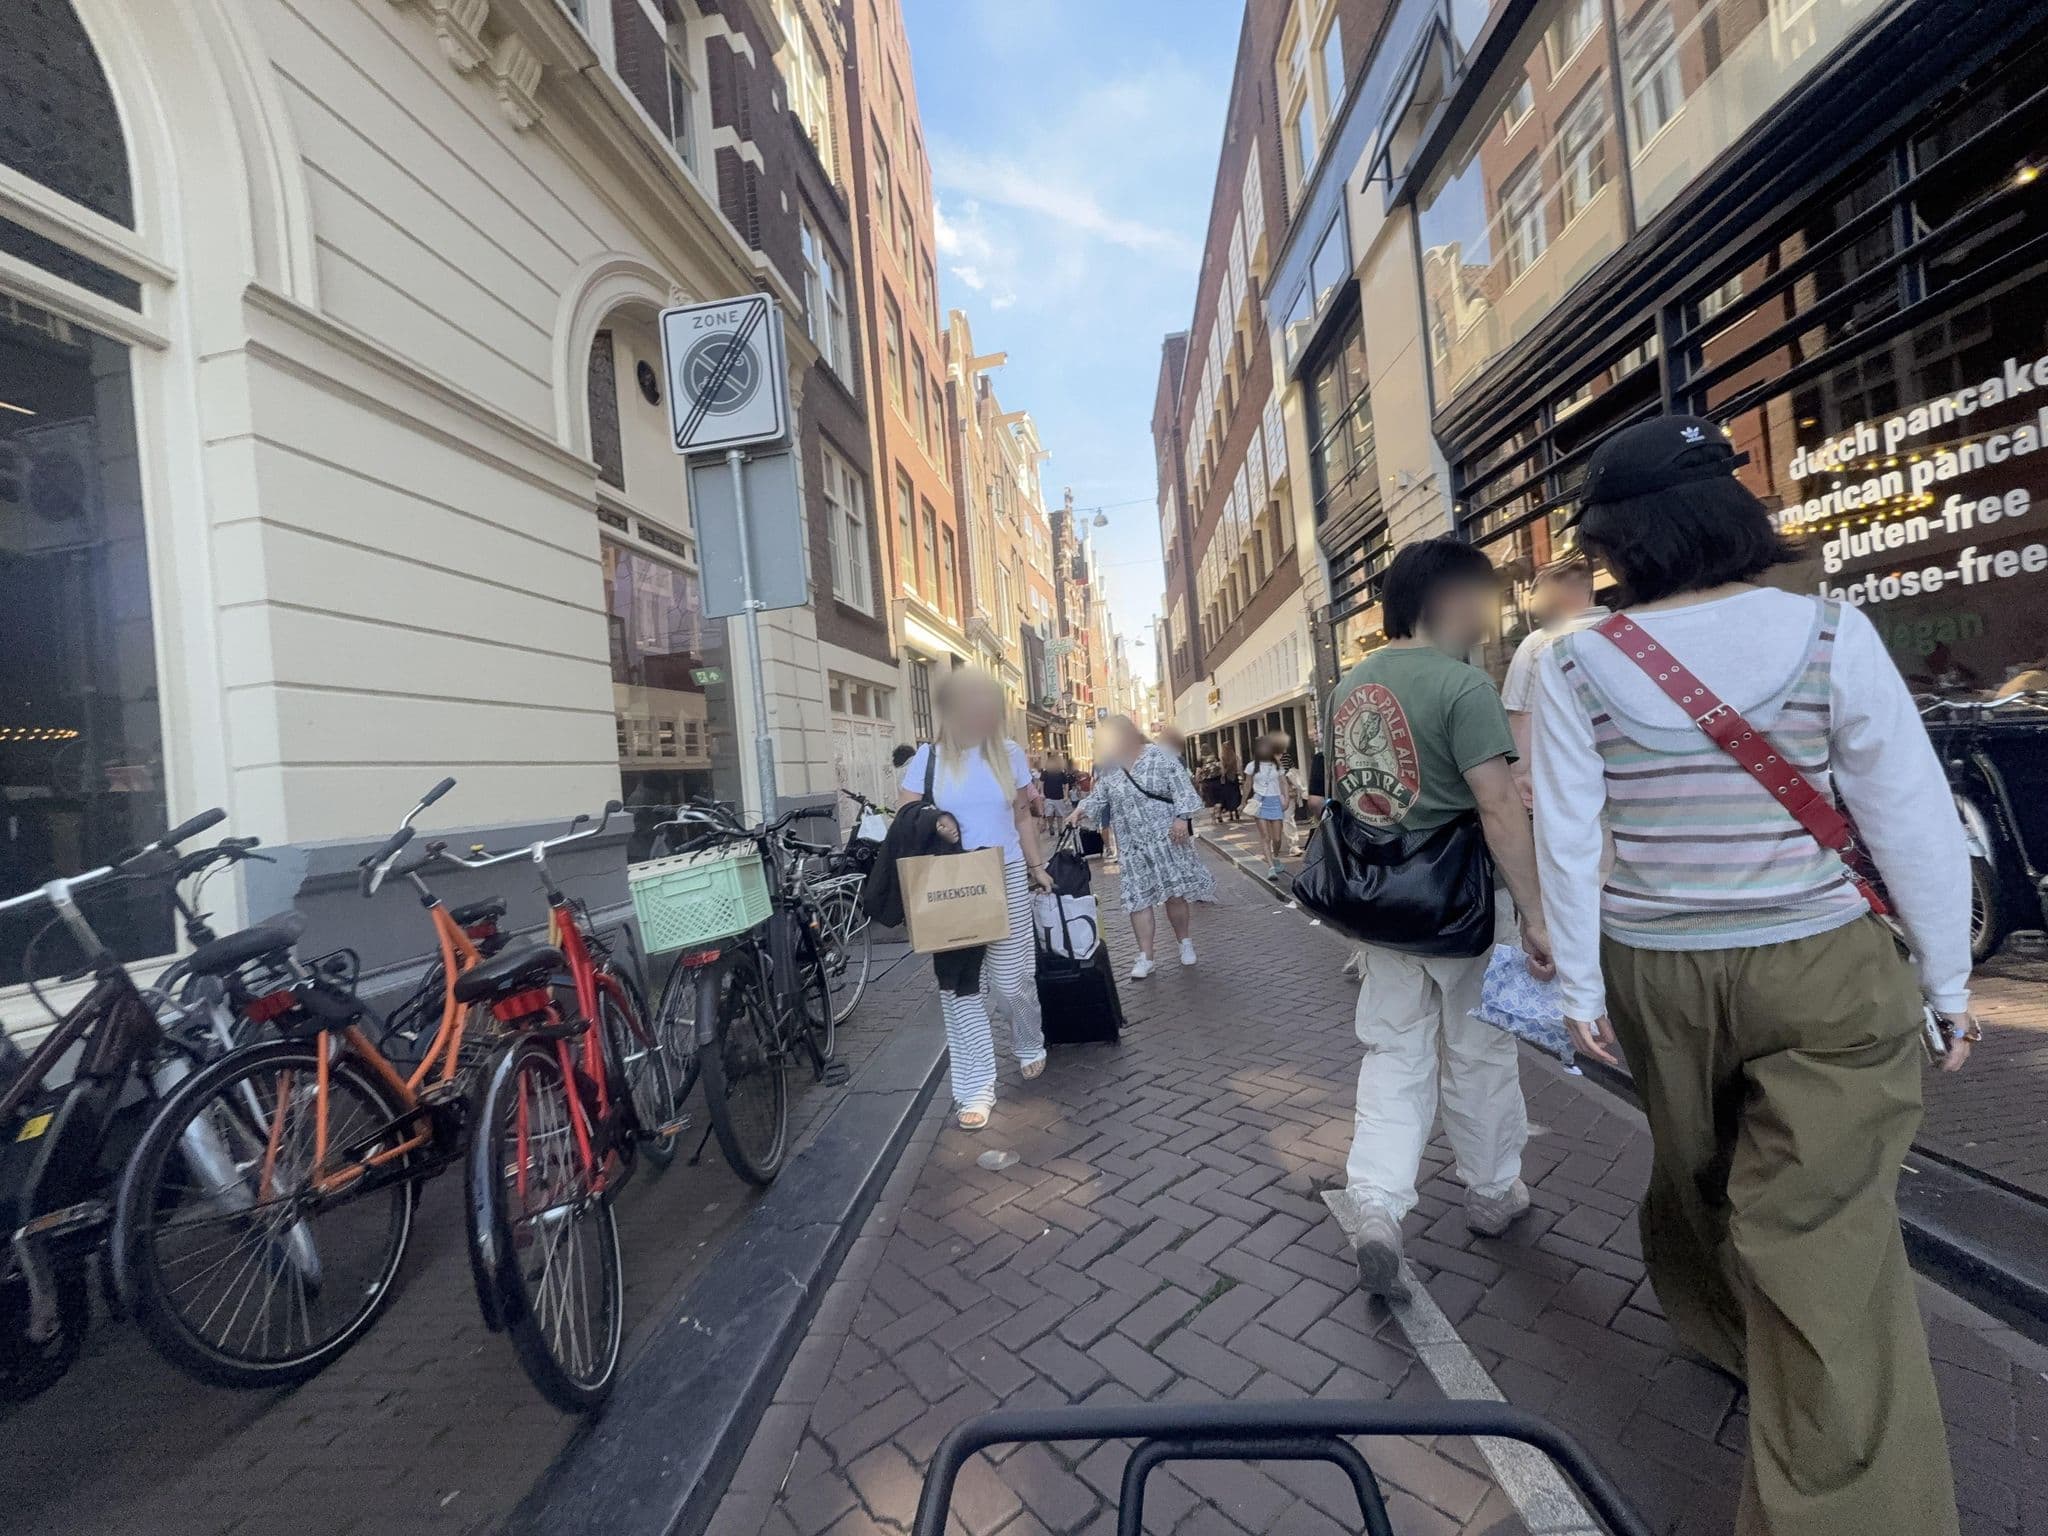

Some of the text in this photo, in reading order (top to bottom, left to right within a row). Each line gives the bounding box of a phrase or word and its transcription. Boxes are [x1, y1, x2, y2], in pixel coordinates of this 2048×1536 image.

[692, 310, 740, 329] ZONE
[1789, 421, 1878, 480] dutch
[1822, 488, 2031, 573] gluten-free
[1881, 613, 1983, 657] egan
[1379, 696, 1406, 740] PALE
[927, 884, 988, 903] BIRKENSTOCK
